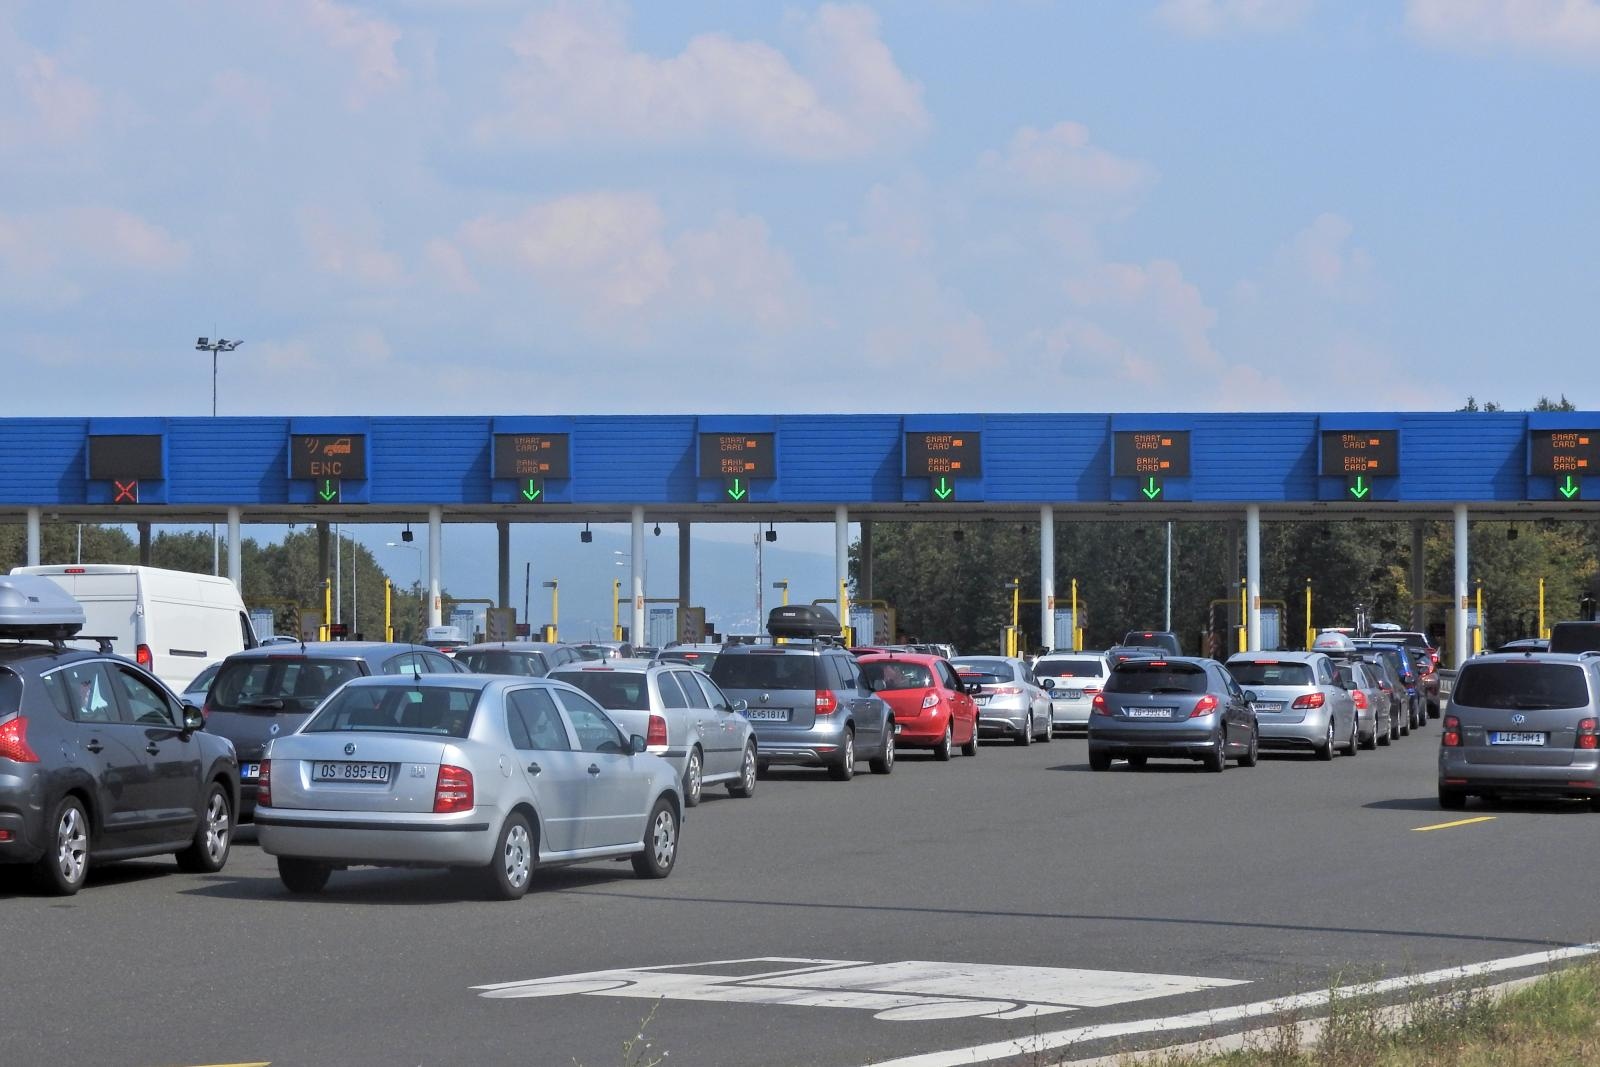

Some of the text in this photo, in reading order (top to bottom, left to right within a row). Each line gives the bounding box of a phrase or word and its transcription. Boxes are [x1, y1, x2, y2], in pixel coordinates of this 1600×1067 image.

[926, 435, 952, 443] SMART
[1551, 433, 1578, 441] SMART
[927, 442, 950, 450] CARD
[1344, 441, 1366, 449] CARD
[1552, 440, 1576, 448] CARD
[1344, 456, 1367, 464] BANK
[310, 461, 342, 475] ENC
[1136, 464, 1159, 472] CARD
[1344, 463, 1367, 471] CARD
[321, 765, 336, 778] OS
